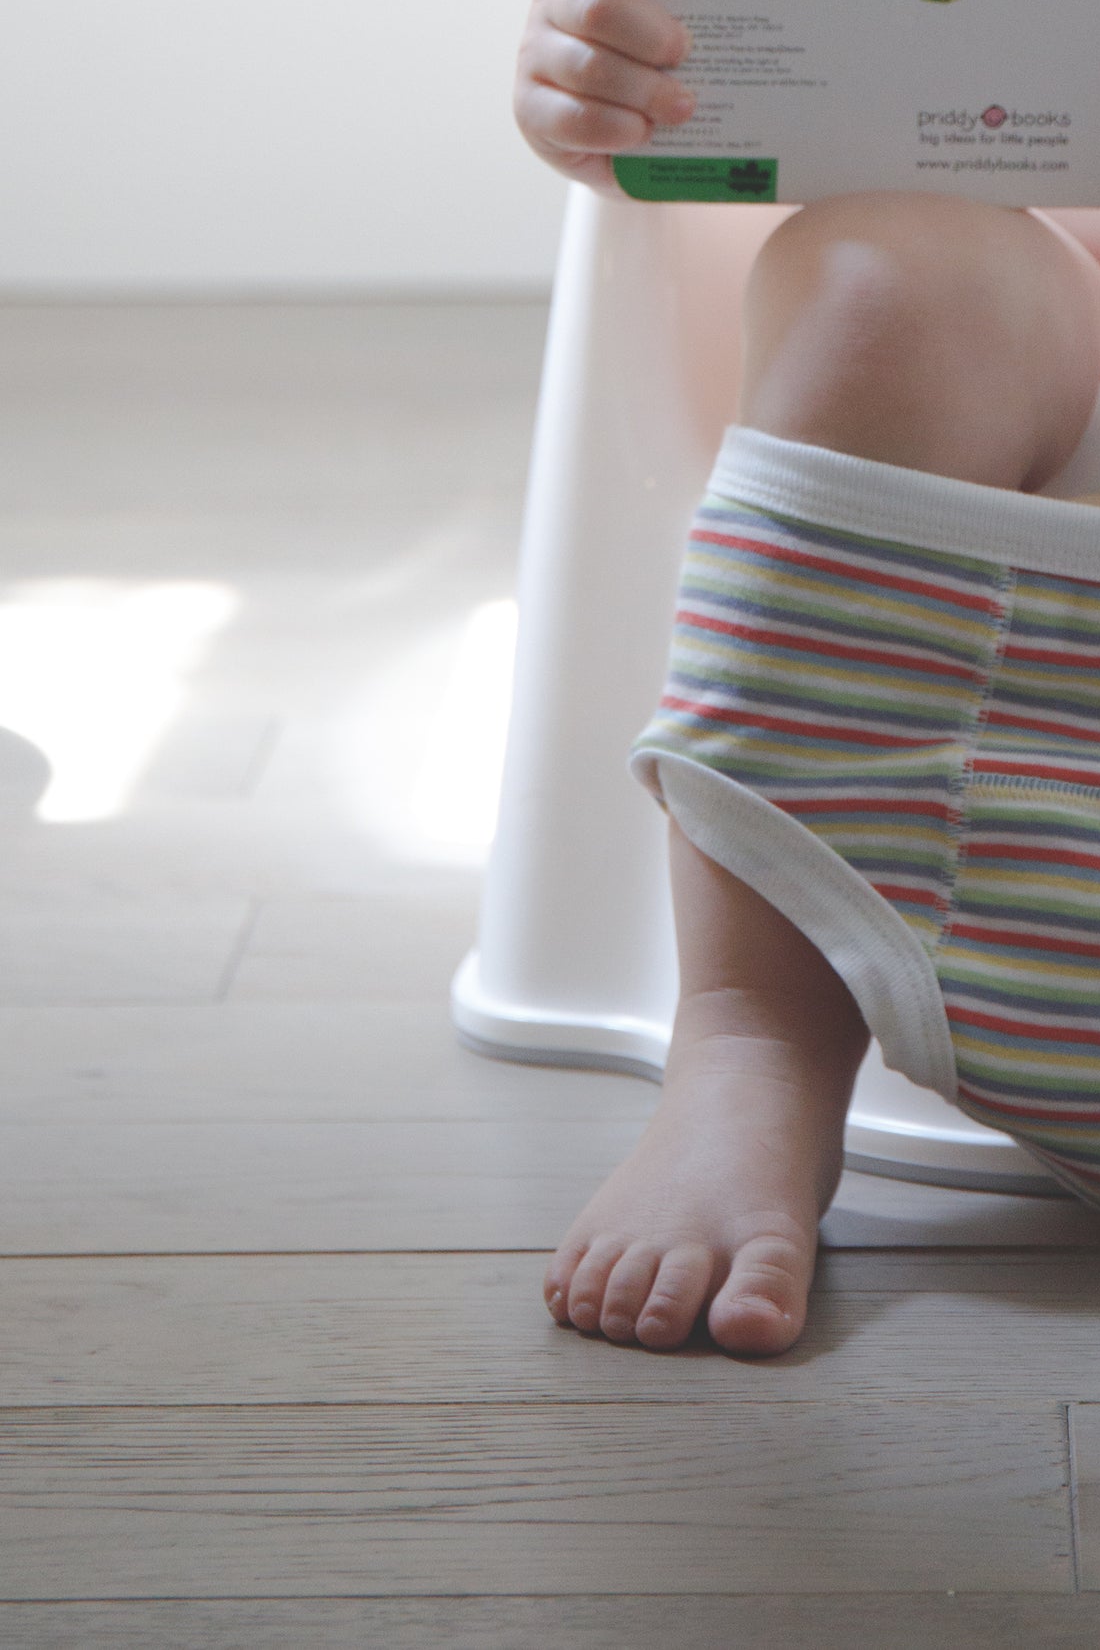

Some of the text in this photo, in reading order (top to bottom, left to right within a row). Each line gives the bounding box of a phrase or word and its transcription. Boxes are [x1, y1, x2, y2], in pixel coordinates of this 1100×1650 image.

[917, 109, 1072, 132] priddy books
[919, 132, 941, 147] big
[944, 132, 977, 145] ideas
[979, 131, 996, 145] for
[1027, 133, 1070, 148] people
[916, 157, 1070, 174] www.priddybooks.com
